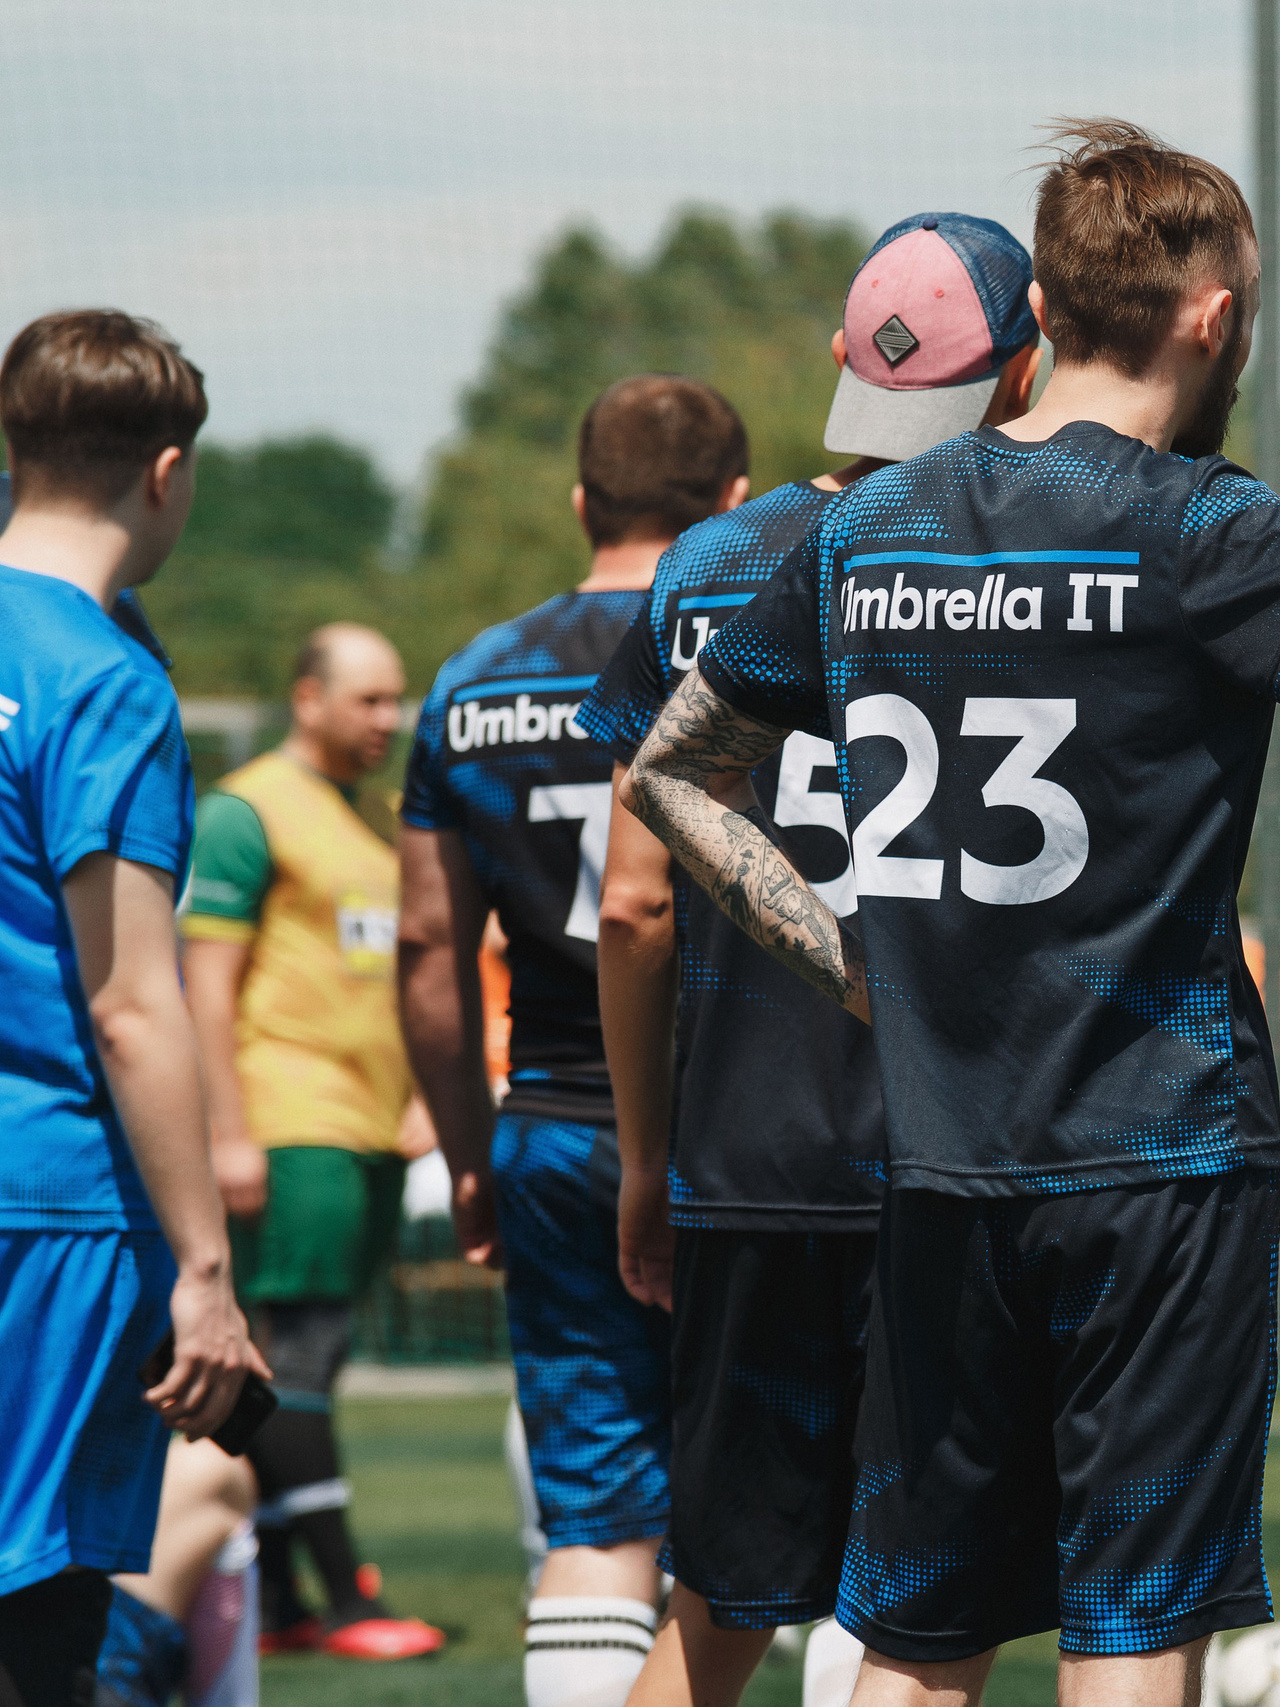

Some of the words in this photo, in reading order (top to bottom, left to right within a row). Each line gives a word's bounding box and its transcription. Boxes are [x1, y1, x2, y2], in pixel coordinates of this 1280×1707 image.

[670, 616, 720, 671] U
[841, 572, 1041, 635] Umbrella
[1066, 573, 1138, 632] IT
[527, 781, 612, 943] 7
[773, 729, 858, 918] 5
[844, 693, 1089, 905] 23
